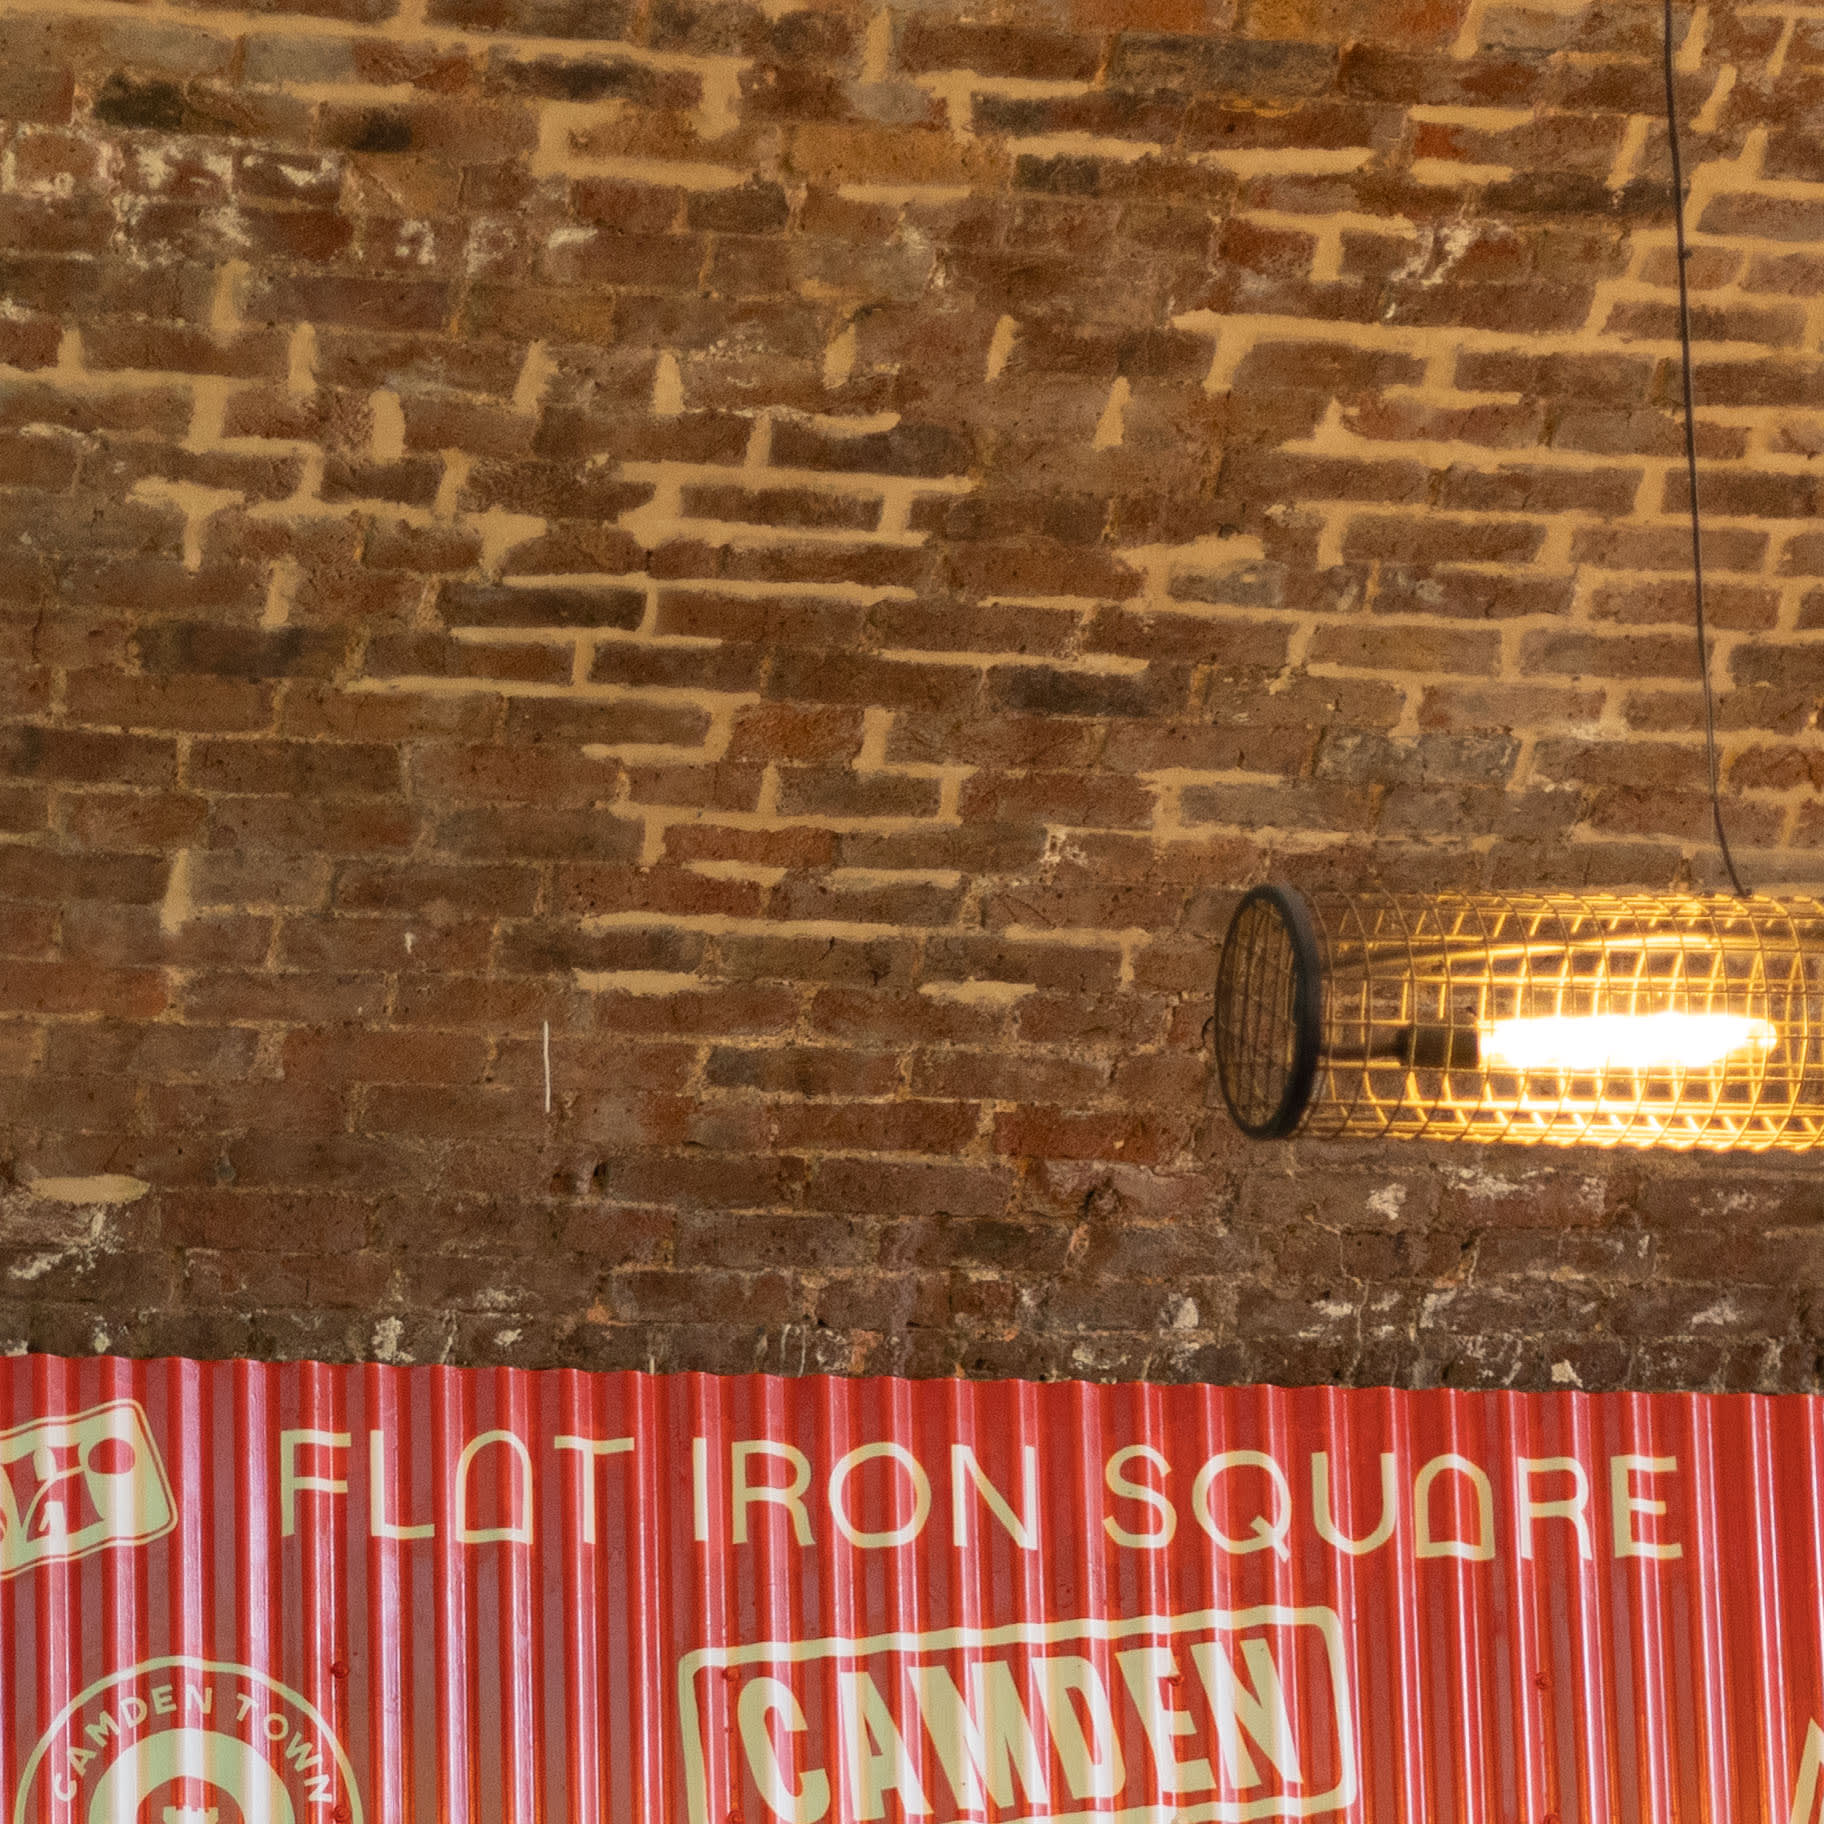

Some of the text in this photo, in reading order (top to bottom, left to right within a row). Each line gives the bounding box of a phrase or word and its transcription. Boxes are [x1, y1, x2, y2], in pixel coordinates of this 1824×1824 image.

[280, 1429, 1684, 1562] FLAT IRON SQUARE
[54, 1683, 332, 1806] CAMDEN TOWN
